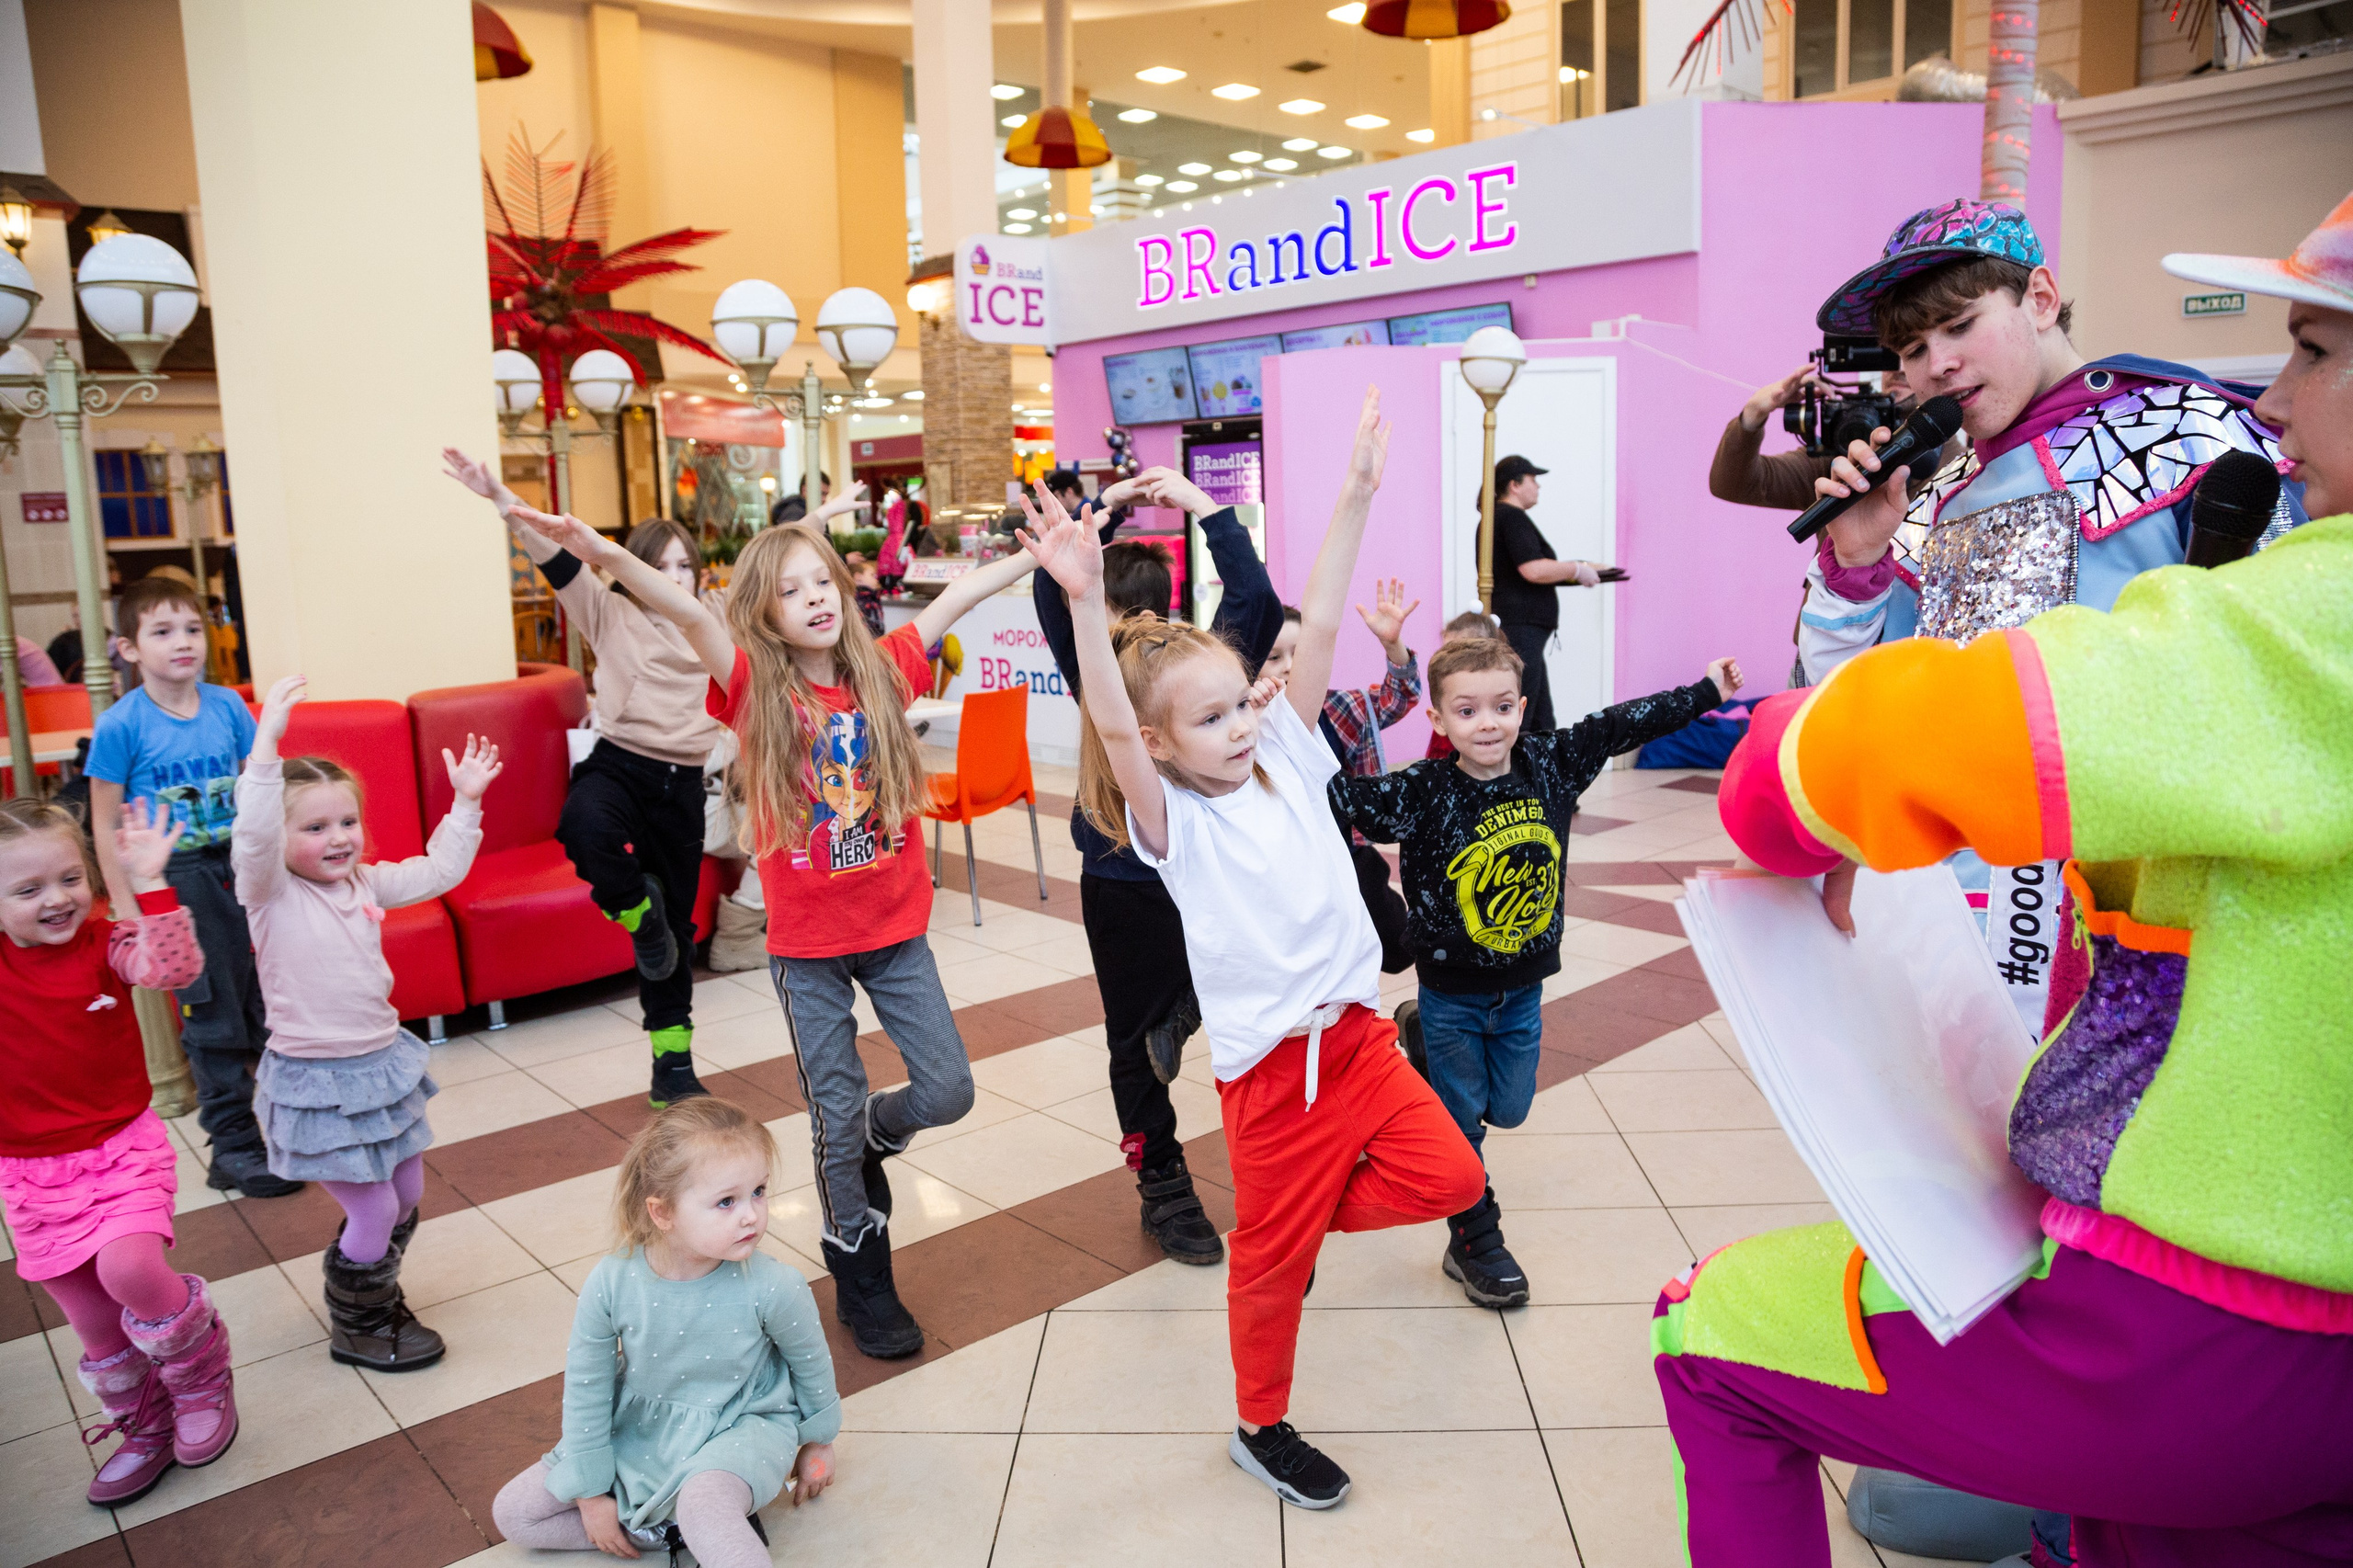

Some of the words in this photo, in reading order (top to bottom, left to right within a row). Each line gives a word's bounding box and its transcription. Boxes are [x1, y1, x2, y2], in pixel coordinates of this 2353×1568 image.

[996, 262, 1043, 280] BRand
[969, 282, 1044, 327] ICE
[2188, 295, 2242, 312] ВЫХОД
[1193, 451, 1261, 471] BRandICE
[1194, 469, 1261, 488] BRandICE
[979, 657, 1073, 697] BRand
[1482, 808, 1496, 819] THE
[1496, 801, 1514, 812] BEST
[845, 830, 849, 840] I
[850, 825, 863, 838] AM
[831, 834, 874, 869] HERO
[1447, 841, 1534, 892] New
[1537, 860, 1554, 892] 37
